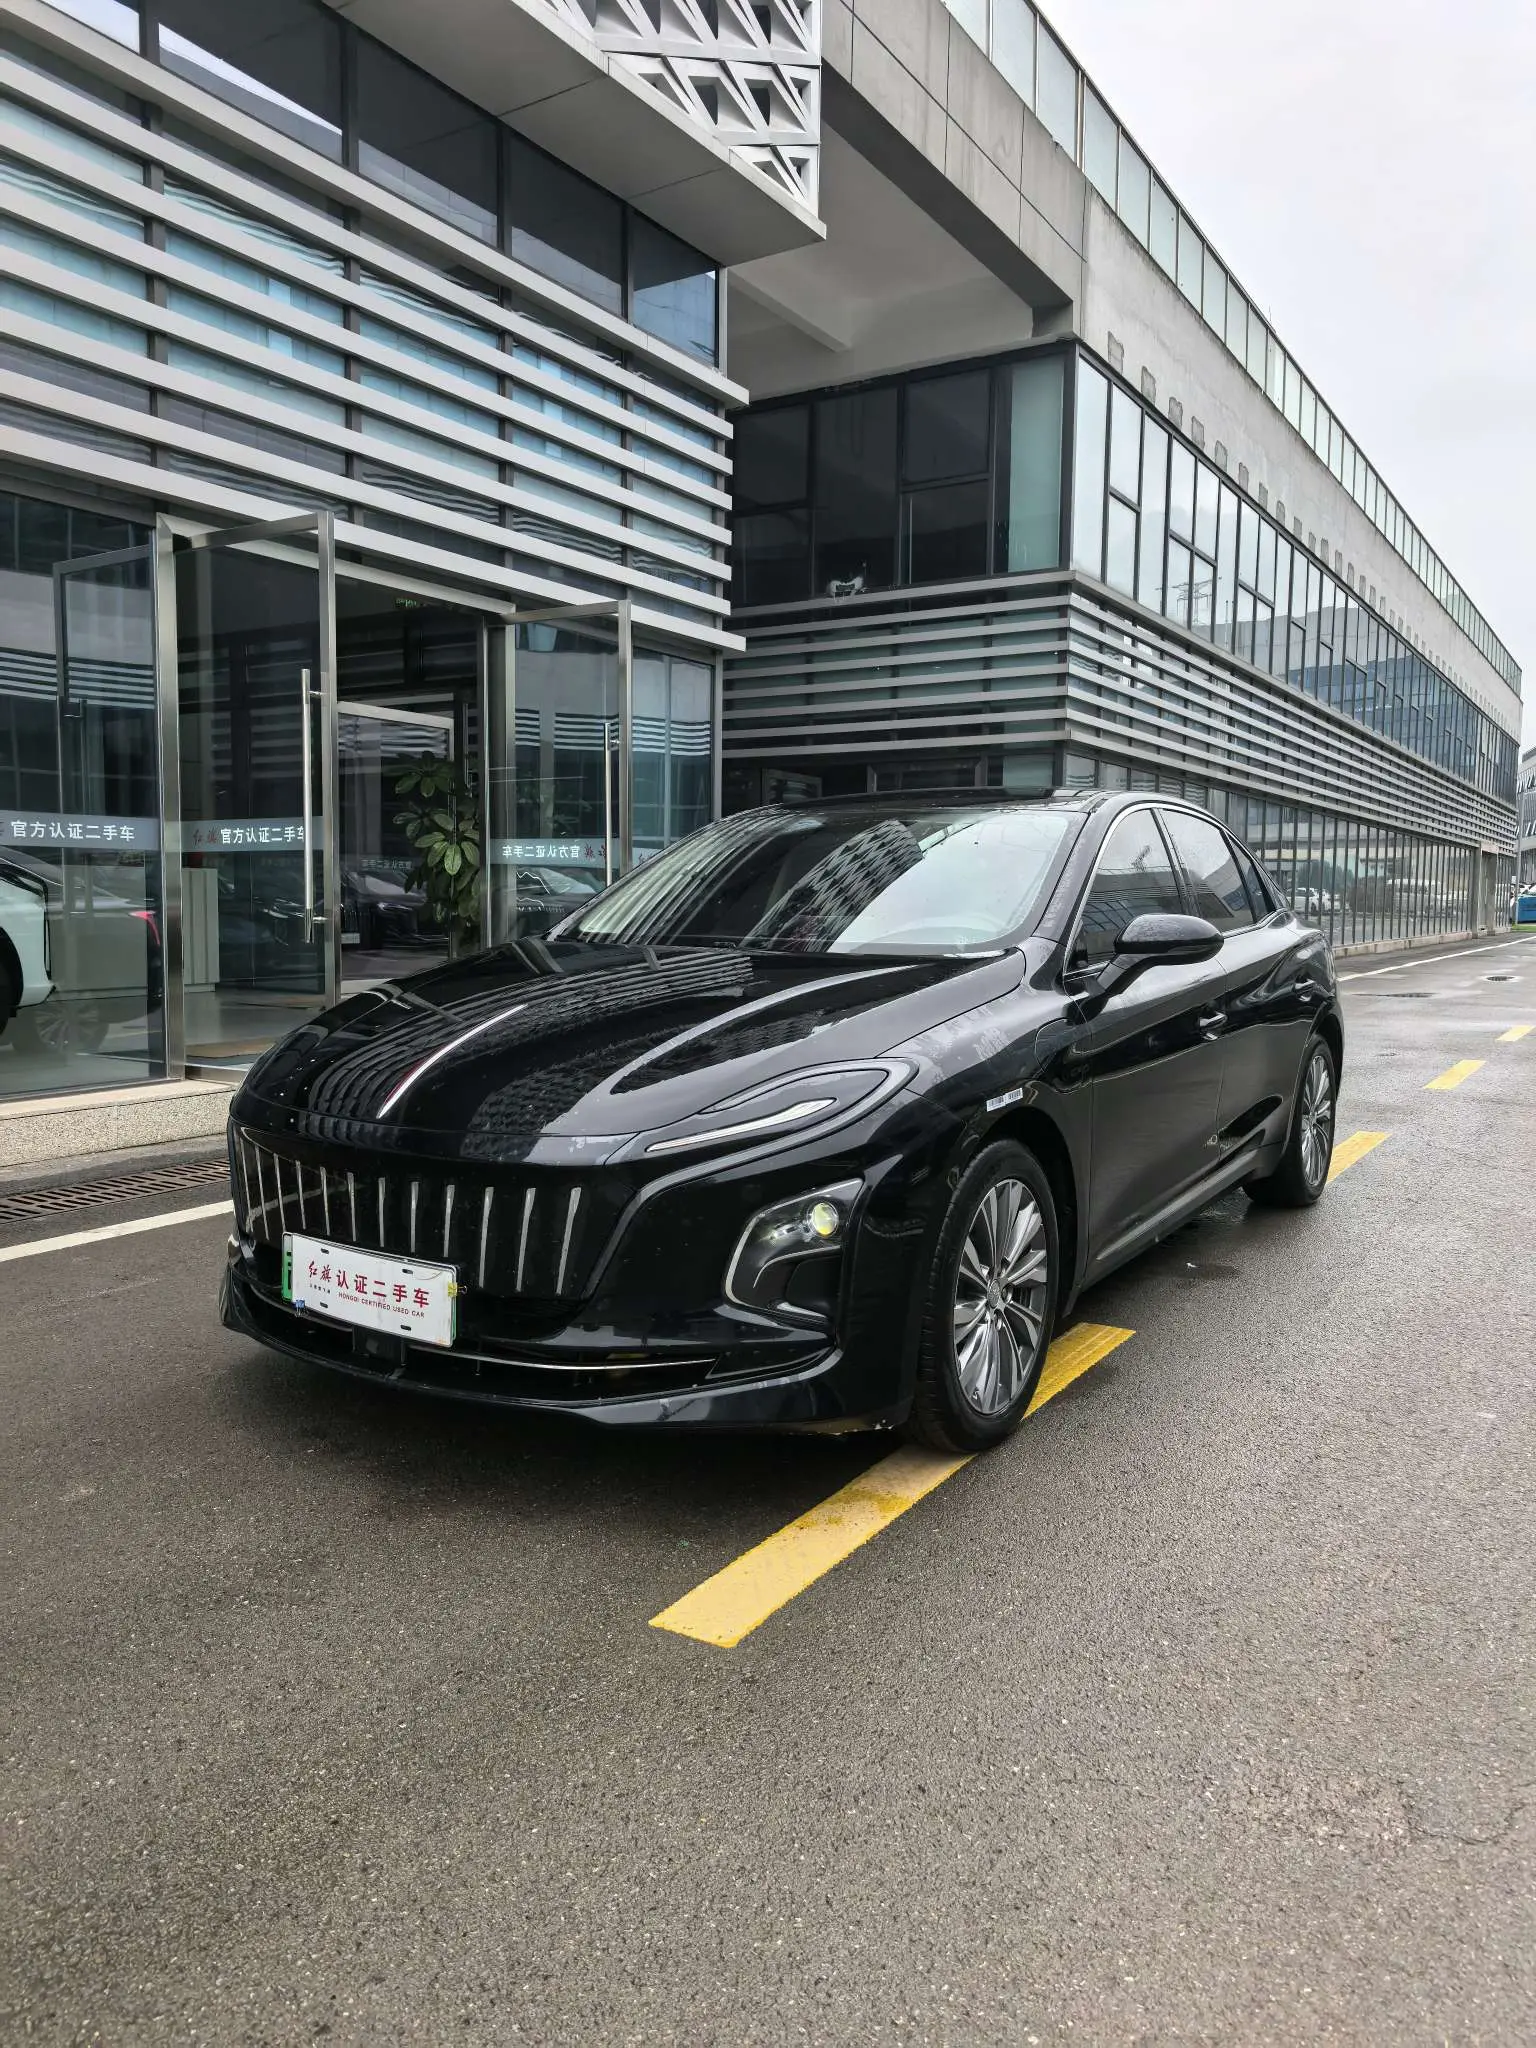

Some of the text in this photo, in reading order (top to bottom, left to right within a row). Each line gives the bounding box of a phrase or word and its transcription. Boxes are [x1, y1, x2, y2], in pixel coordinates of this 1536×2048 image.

[10, 820, 135, 842] 官方认证二手车
[411, 1310, 425, 1318] CAR
